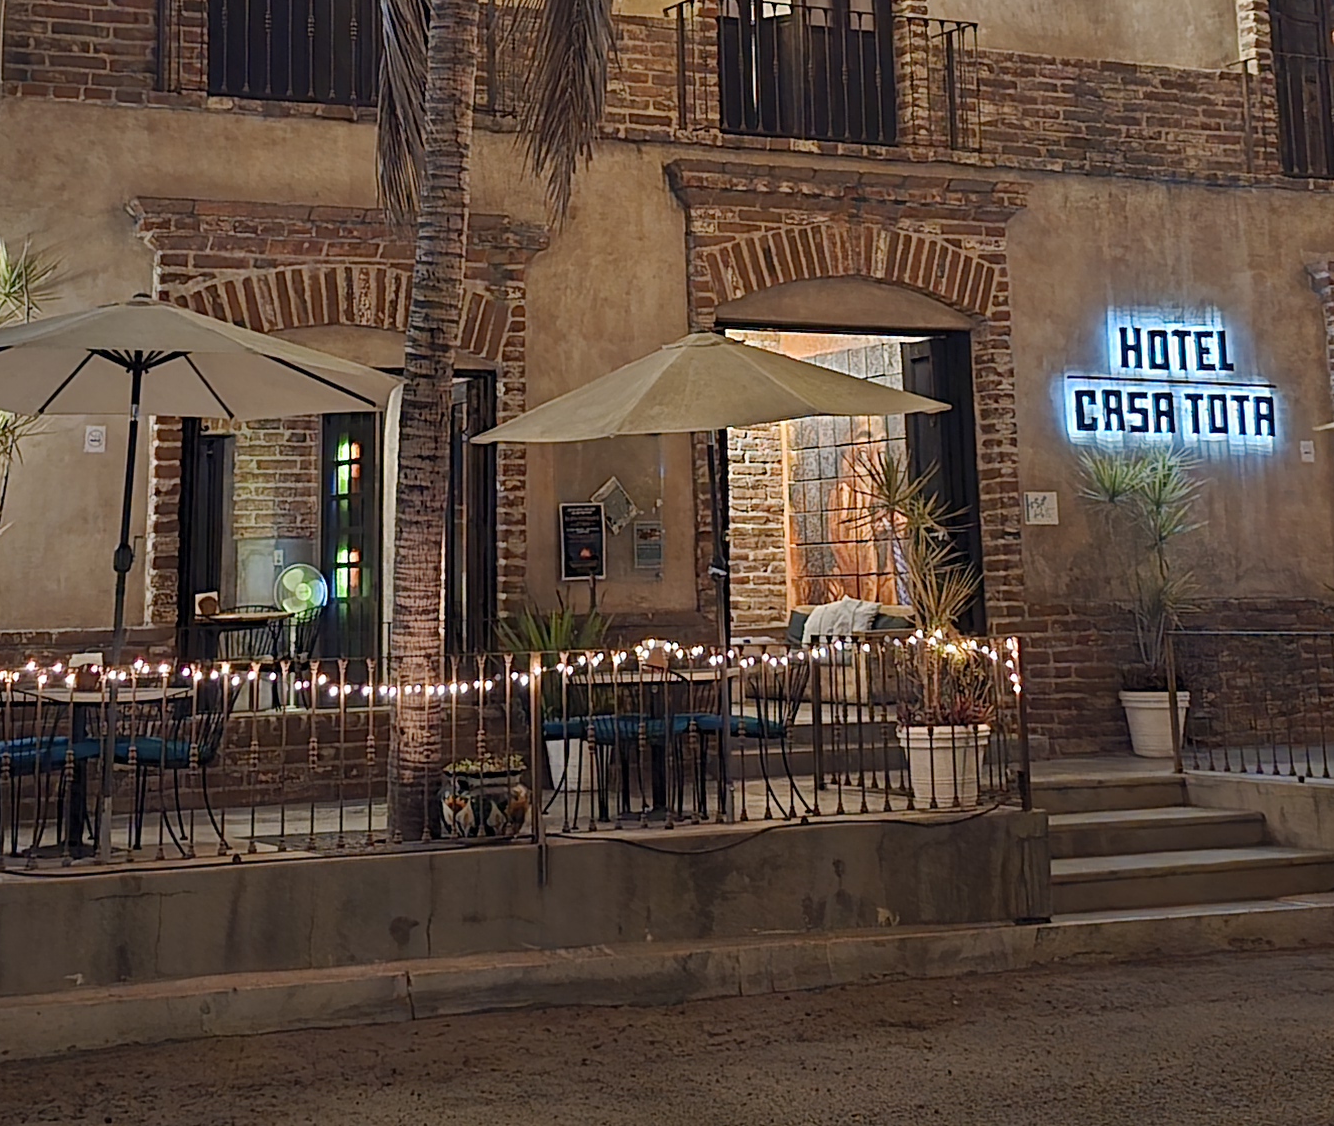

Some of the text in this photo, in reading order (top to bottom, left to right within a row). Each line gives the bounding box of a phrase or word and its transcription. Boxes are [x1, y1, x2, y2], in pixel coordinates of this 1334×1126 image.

[1119, 327, 1235, 372] HOTEL
[1074, 389, 1276, 437] CASA TOTA
